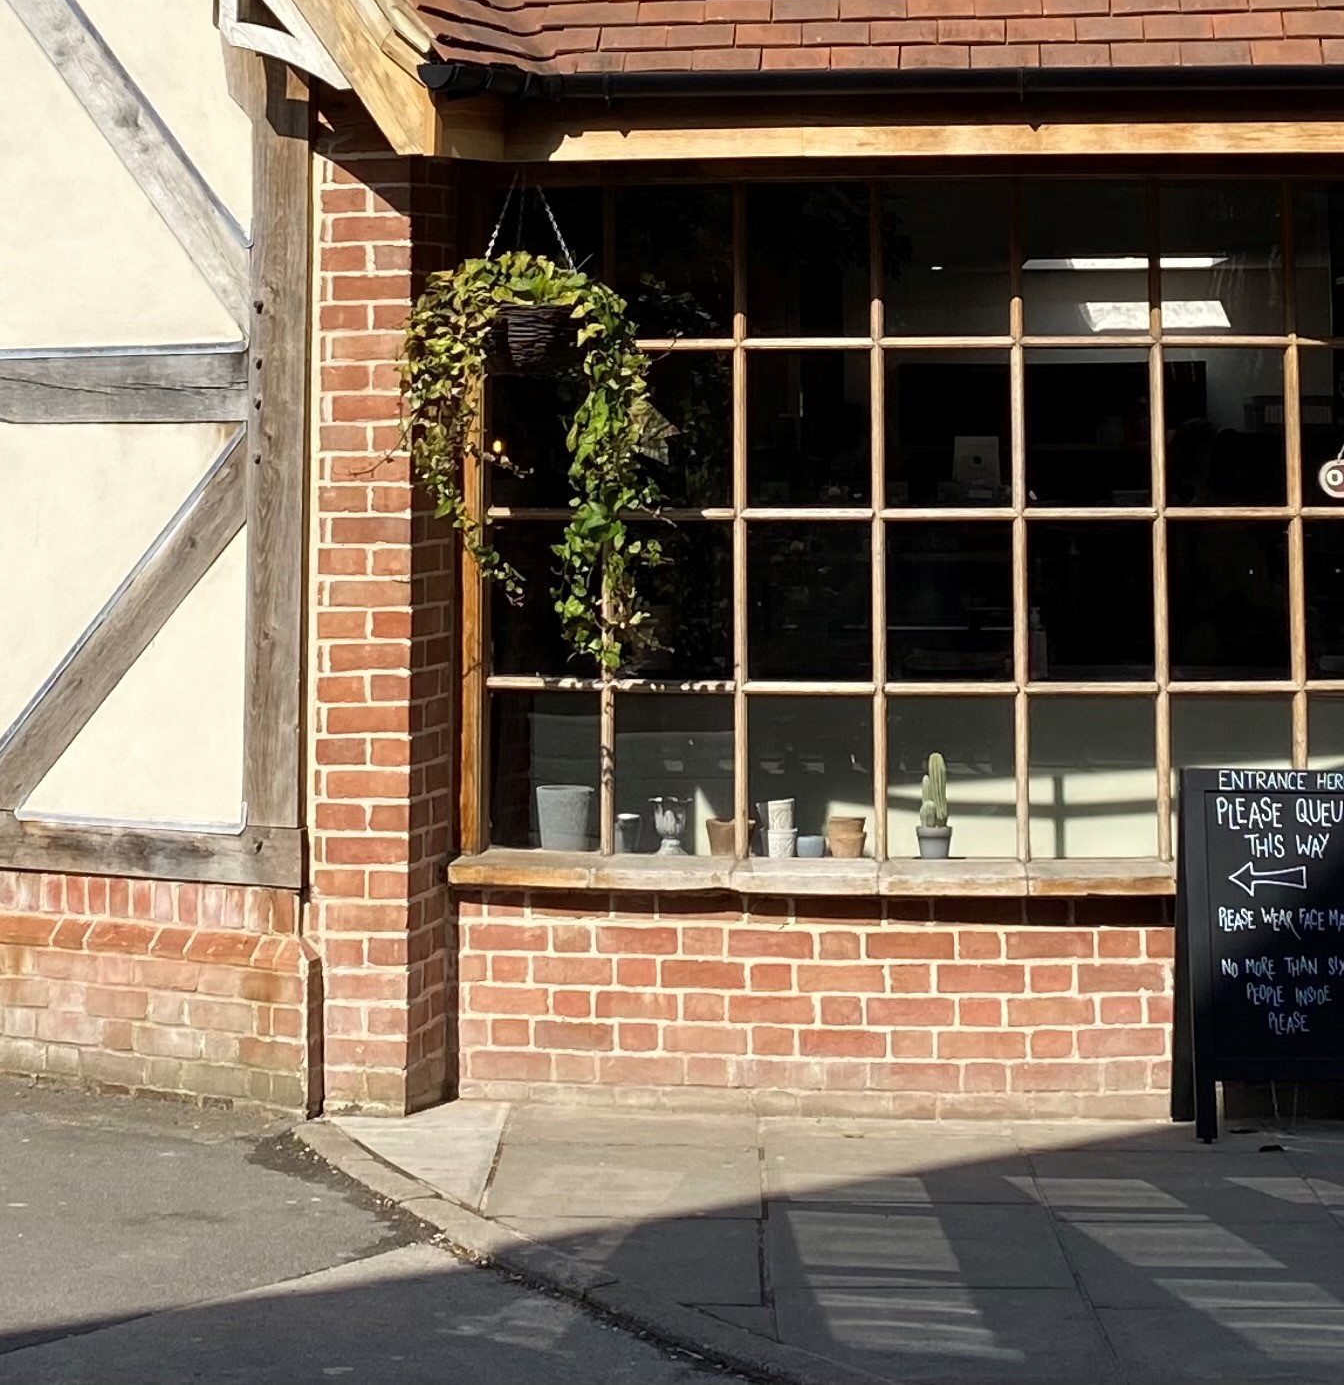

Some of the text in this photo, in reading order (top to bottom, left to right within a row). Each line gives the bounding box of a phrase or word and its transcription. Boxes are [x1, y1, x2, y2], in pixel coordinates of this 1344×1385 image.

[1218, 769, 1308, 790] ENTRANCE
[1216, 796, 1283, 830] PLEASE
[1244, 832, 1330, 859] THIS WAY
[1218, 906, 1256, 932] PLEASE
[1260, 906, 1301, 940] WEAR
[1299, 908, 1326, 931] FACE
[1221, 958, 1239, 979] NO
[1244, 956, 1276, 981] MORE
[1284, 955, 1318, 977] THAN
[1246, 981, 1332, 1007] PEOPLE INSIDE
[1268, 1011, 1310, 1035] PLEASE
